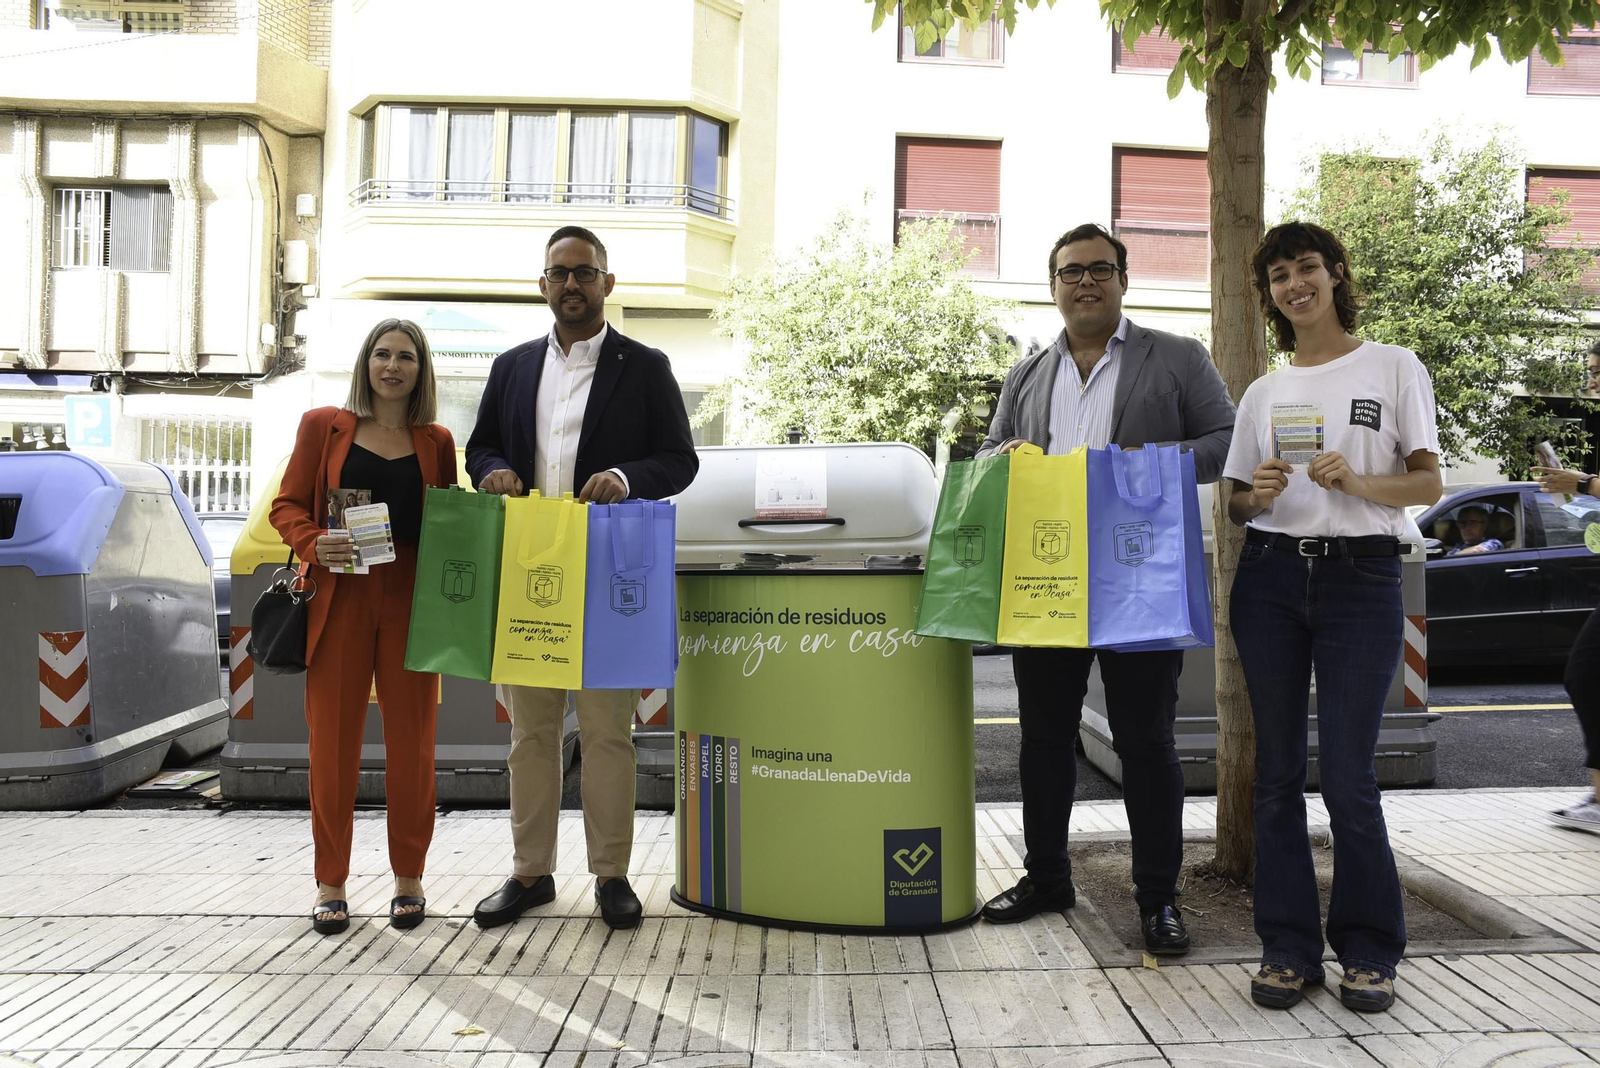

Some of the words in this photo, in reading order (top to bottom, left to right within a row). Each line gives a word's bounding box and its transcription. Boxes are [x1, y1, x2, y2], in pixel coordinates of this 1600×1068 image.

[1355, 408, 1378, 418] green
[1356, 401, 1378, 411] urban
[73, 401, 102, 443] P
[1354, 414, 1373, 423] club
[1014, 582, 1060, 597] comienza
[1030, 591, 1042, 599] en
[1050, 590, 1072, 600] casa
[680, 606, 691, 622] La
[693, 607, 774, 627] separación
[777, 607, 801, 625] de
[805, 607, 887, 625] residuos
[509, 626, 554, 641] comienza
[544, 635, 566, 645] casa
[678, 632, 788, 677] comienza
[799, 632, 836, 654] en
[849, 627, 925, 657] casa
[701, 743, 709, 778] PAPEL
[751, 745, 804, 763] Imagina
[806, 752, 833, 763] una
[714, 744, 723, 784] VIDRIO
[729, 745, 738, 784] RESTO
[751, 764, 912, 783] #GranadaLlenaDeVida
[890, 879, 937, 889] Diputación
[901, 887, 938, 896] Granada
